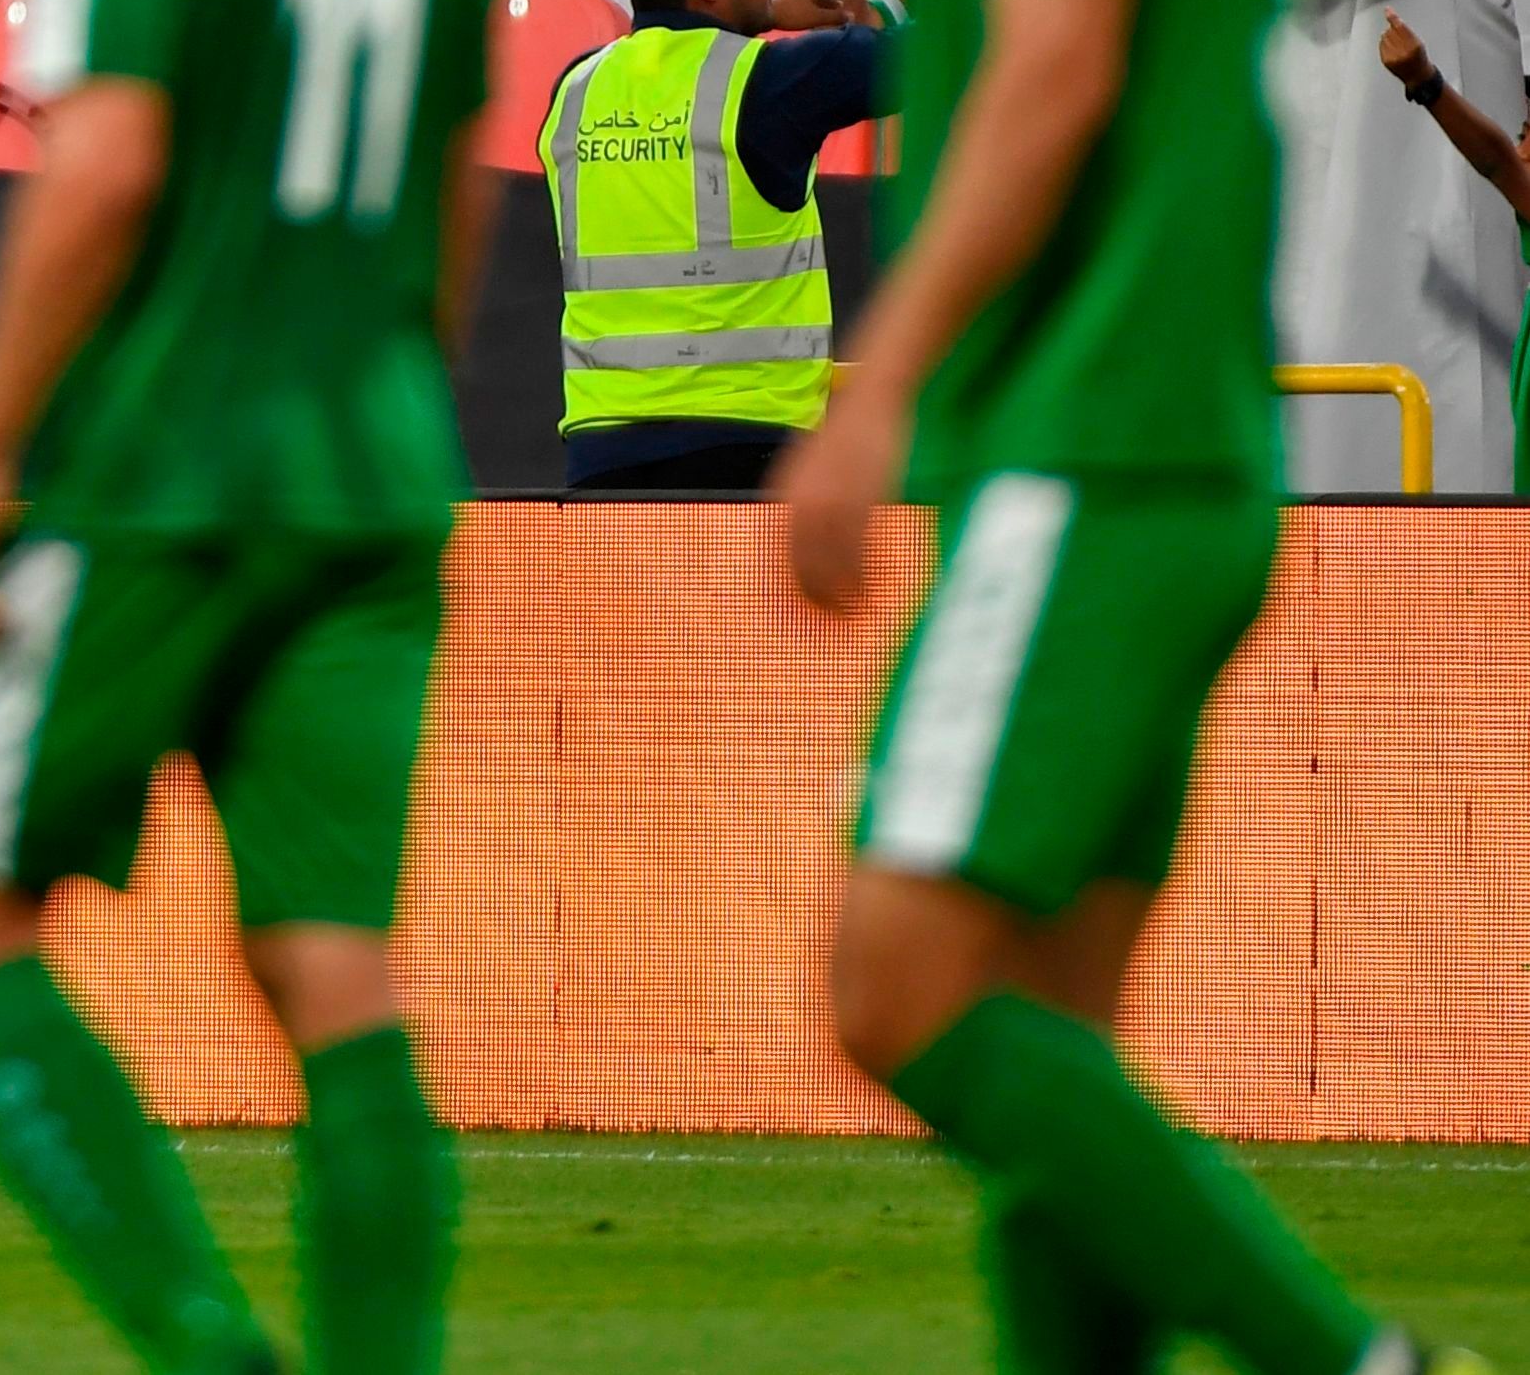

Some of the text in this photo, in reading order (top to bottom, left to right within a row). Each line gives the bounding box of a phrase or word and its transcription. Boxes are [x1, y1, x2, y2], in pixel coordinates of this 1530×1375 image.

[578, 100, 691, 136] أمن خاص
[577, 135, 686, 163] SECURITY
